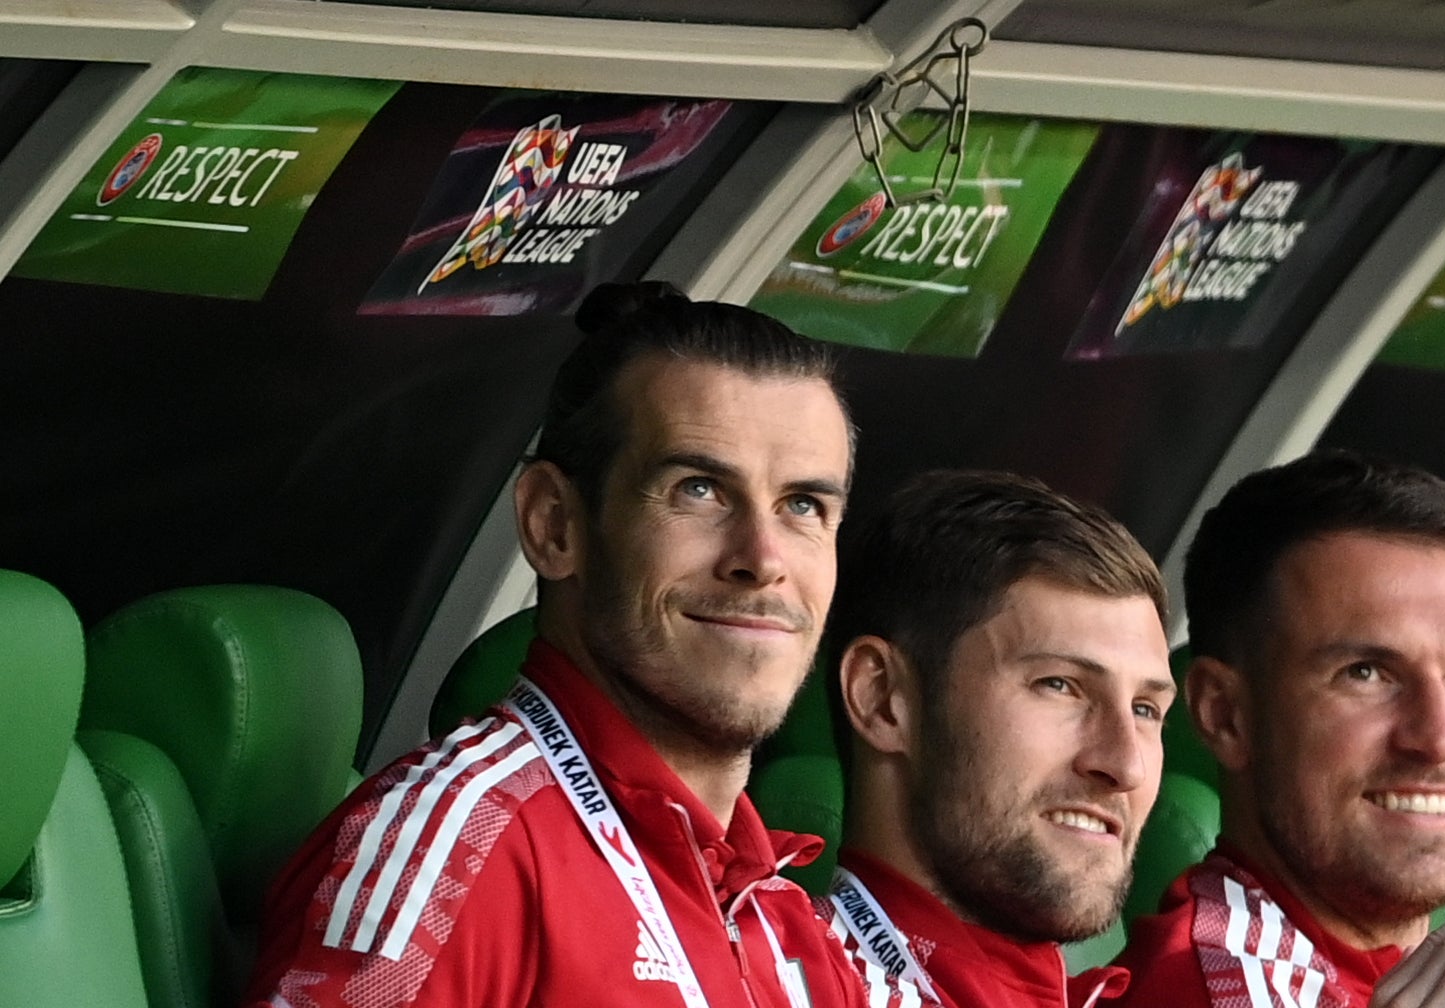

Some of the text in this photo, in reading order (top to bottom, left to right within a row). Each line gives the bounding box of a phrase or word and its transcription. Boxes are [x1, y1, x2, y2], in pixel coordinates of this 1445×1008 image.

[136, 145, 299, 207] RESPECT
[567, 142, 627, 185] UEFA
[536, 187, 640, 225] NATIONS
[1240, 181, 1300, 218] UEFA
[502, 228, 598, 263] LEAGUE
[860, 203, 1008, 268] RESPECT
[1207, 221, 1306, 260] NATIONS
[1183, 259, 1271, 300] LEAGUE
[558, 755, 607, 815] KATAR
[868, 929, 907, 977] KATAR
